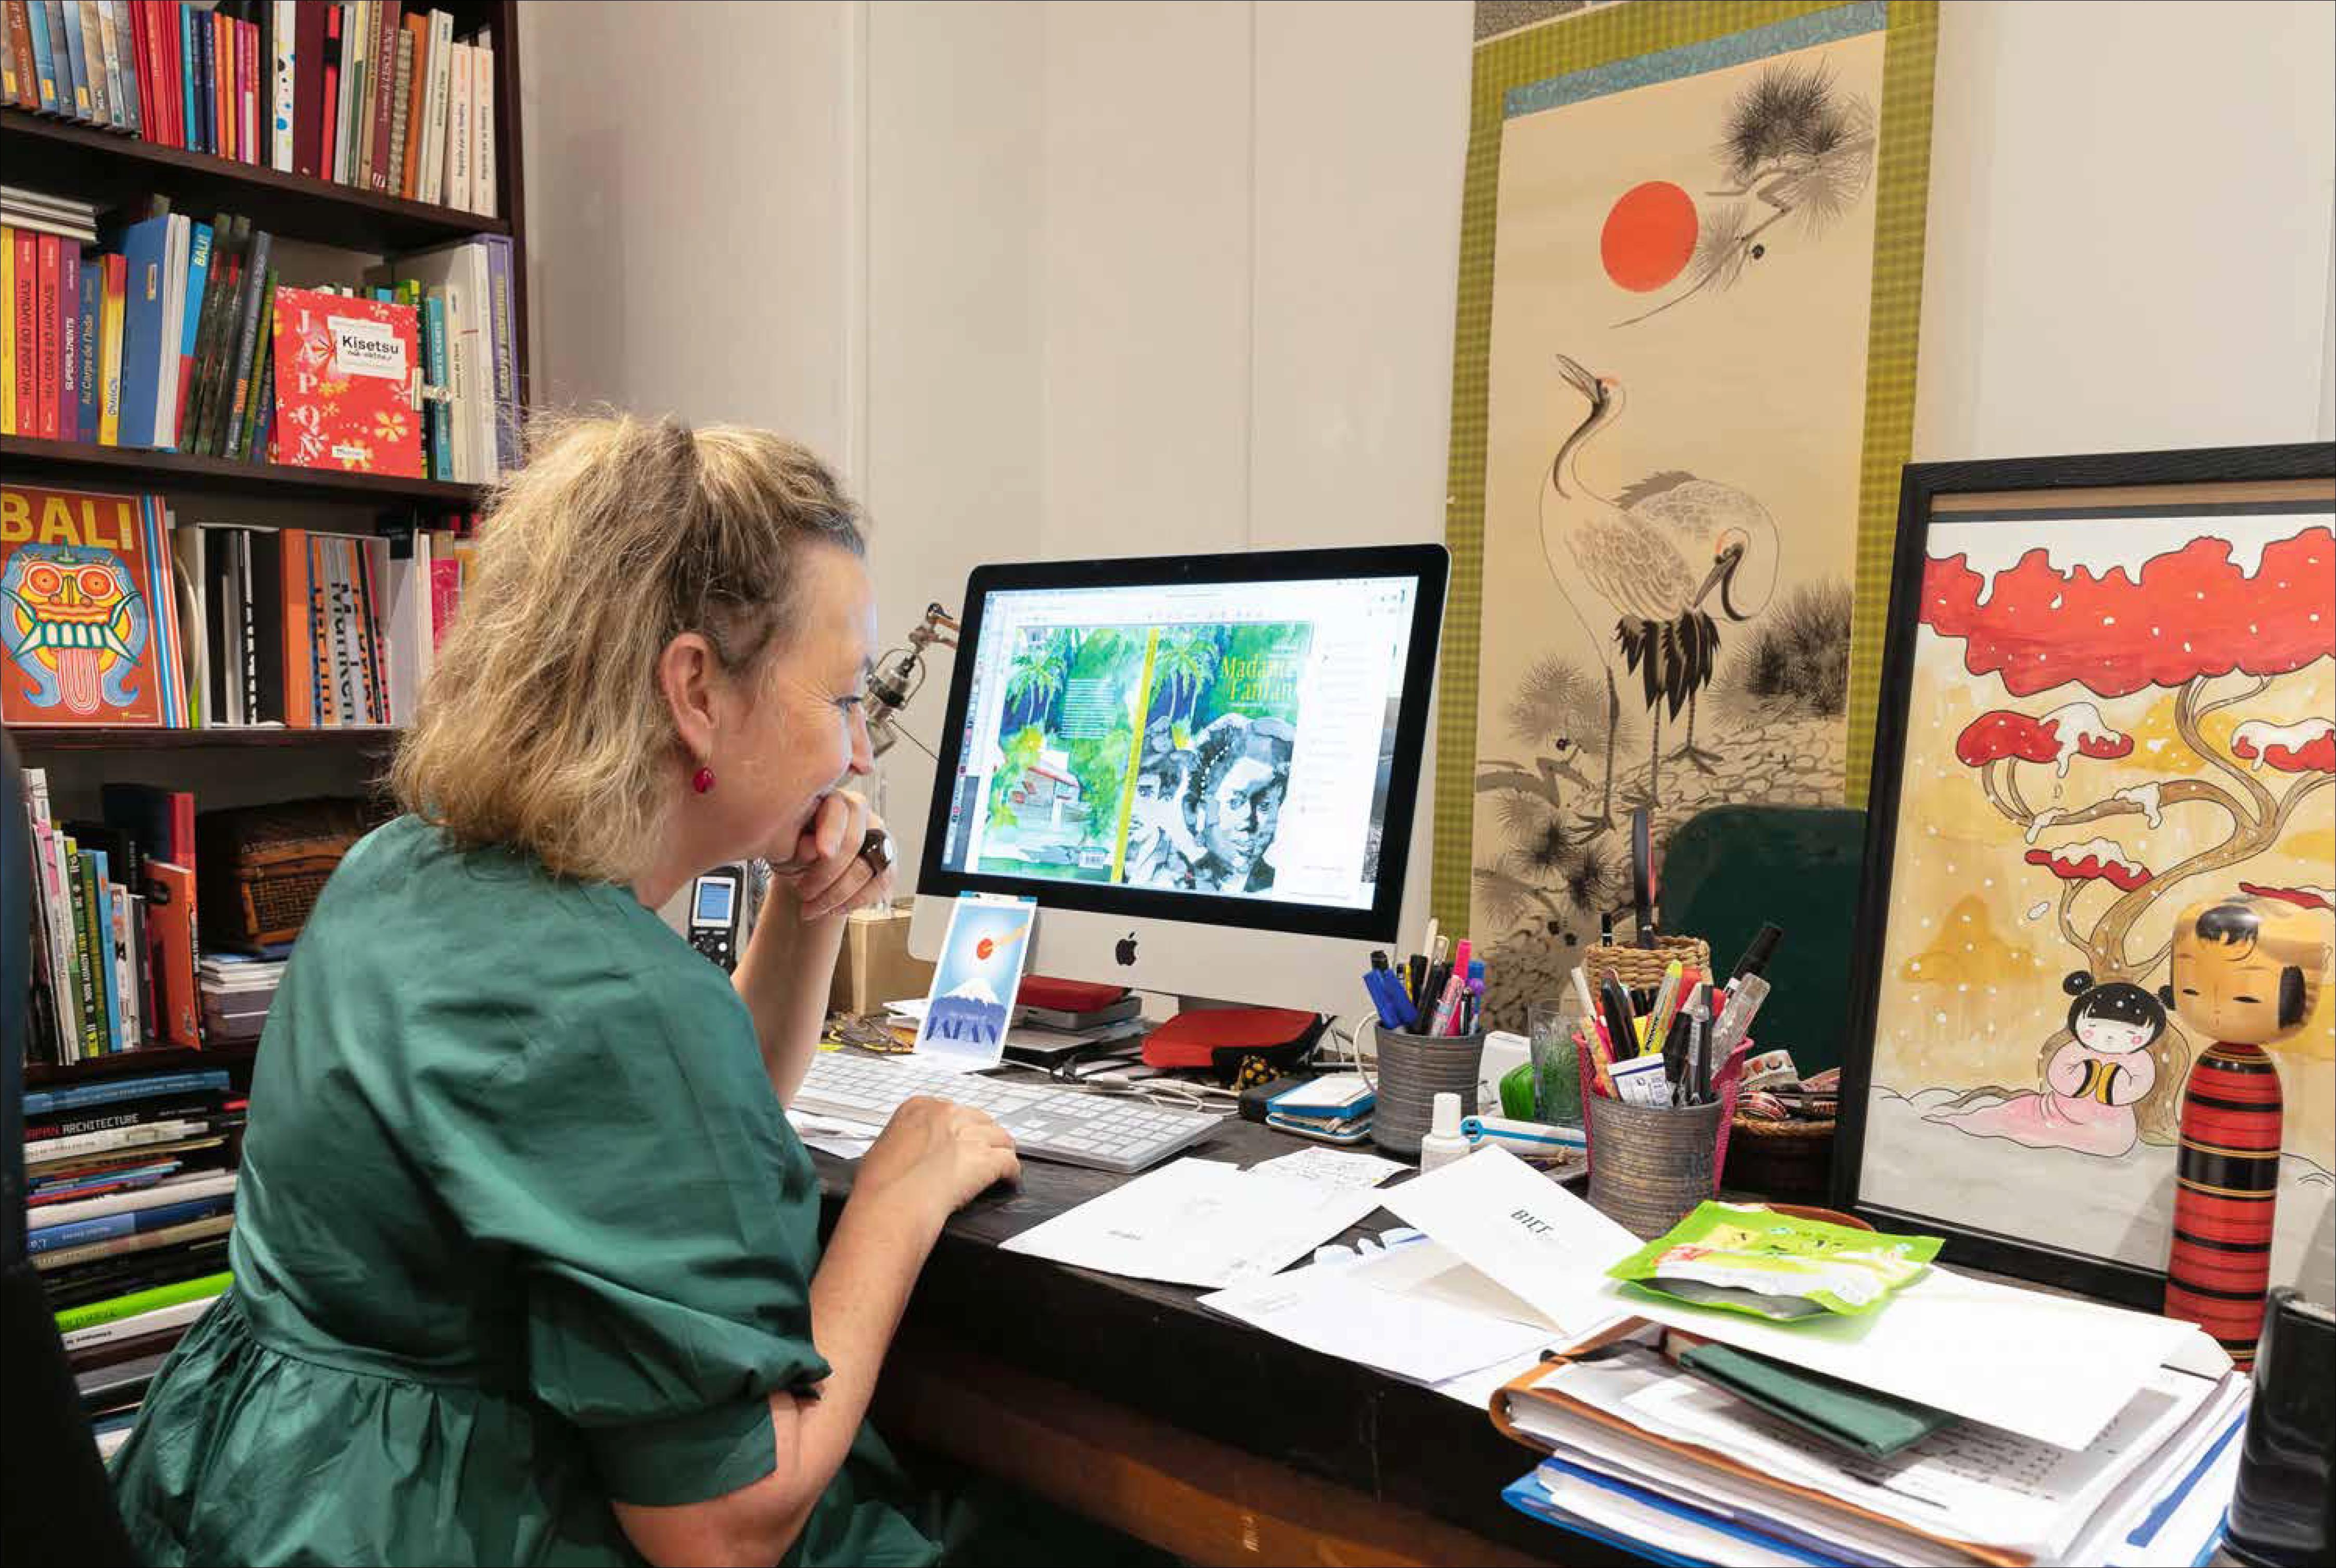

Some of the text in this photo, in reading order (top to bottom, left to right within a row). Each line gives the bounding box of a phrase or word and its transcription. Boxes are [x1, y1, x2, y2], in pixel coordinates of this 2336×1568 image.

[342, 335, 399, 354] Kisetsu
[0, 492, 134, 550] BALI
[62, 1113, 139, 1135] ARCHITECTURE
